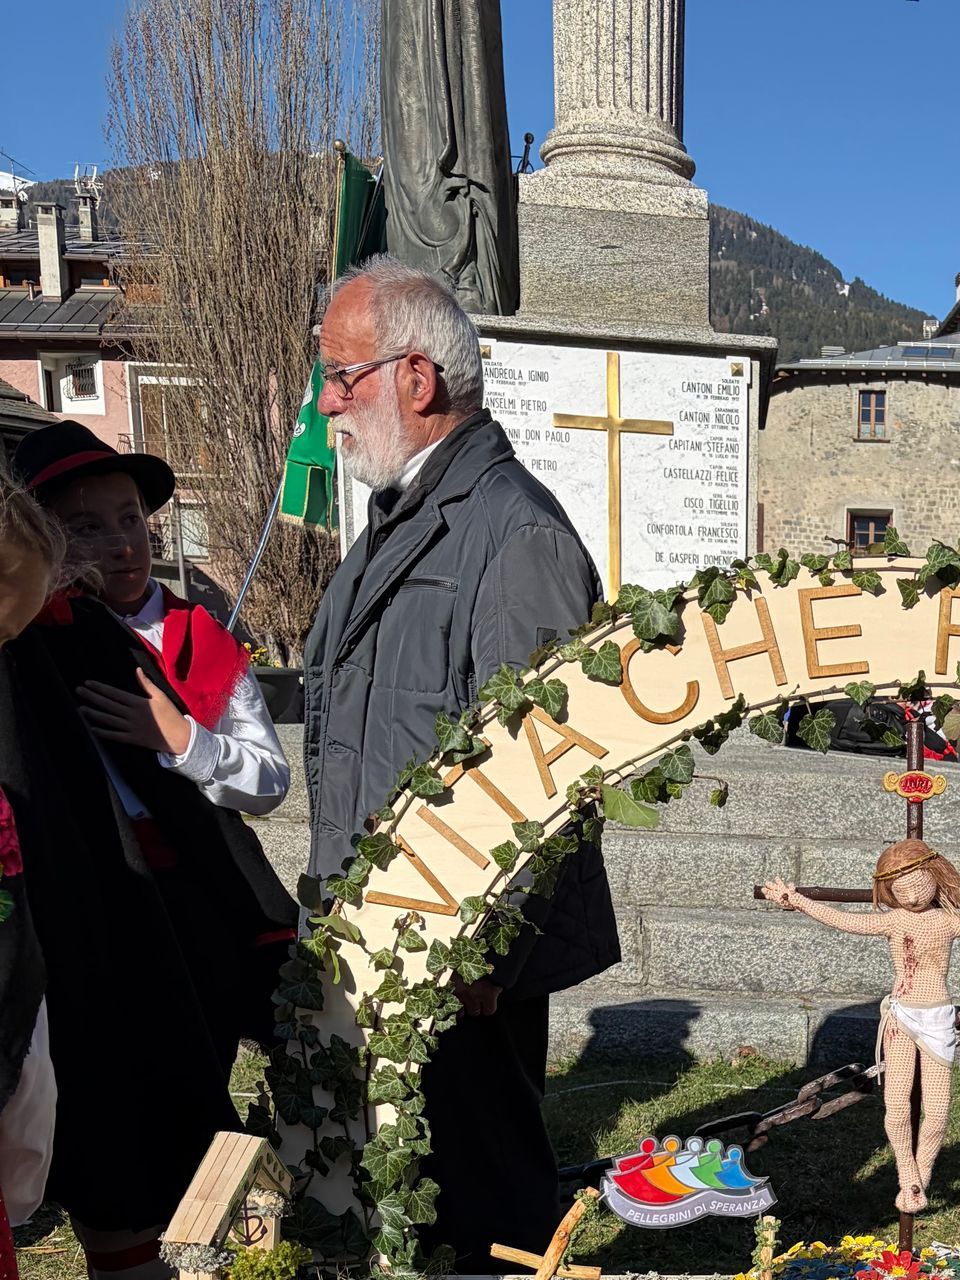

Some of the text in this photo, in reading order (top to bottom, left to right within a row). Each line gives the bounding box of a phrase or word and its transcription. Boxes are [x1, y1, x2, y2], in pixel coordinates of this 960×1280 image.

[484, 367, 549, 383] ANDREOLA IGINIO
[681, 381, 740, 396] CANTONI EMILIO
[484, 397, 547, 412] ANSELMI PIETRO
[679, 411, 740, 426] CANTONI NICOLO
[525, 429, 541, 441] DON
[545, 430, 570, 443] PAOLO
[668, 438, 740, 454] CAPITANI STEFANO
[531, 459, 558, 472] PIETRO
[663, 467, 739, 483] CASTELLAZZI FELICE
[683, 497, 739, 511] CISCO TIGELLIO
[646, 523, 739, 539] CONFORTOLA FRANCESCO
[655, 551, 664, 563] DE
[669, 552, 700, 565] GASPERI
[365, 706, 608, 916] VITA
[620, 584, 870, 725] CHE
[626, 1197, 768, 1224] PELLEGRINI DI SPERANZA
